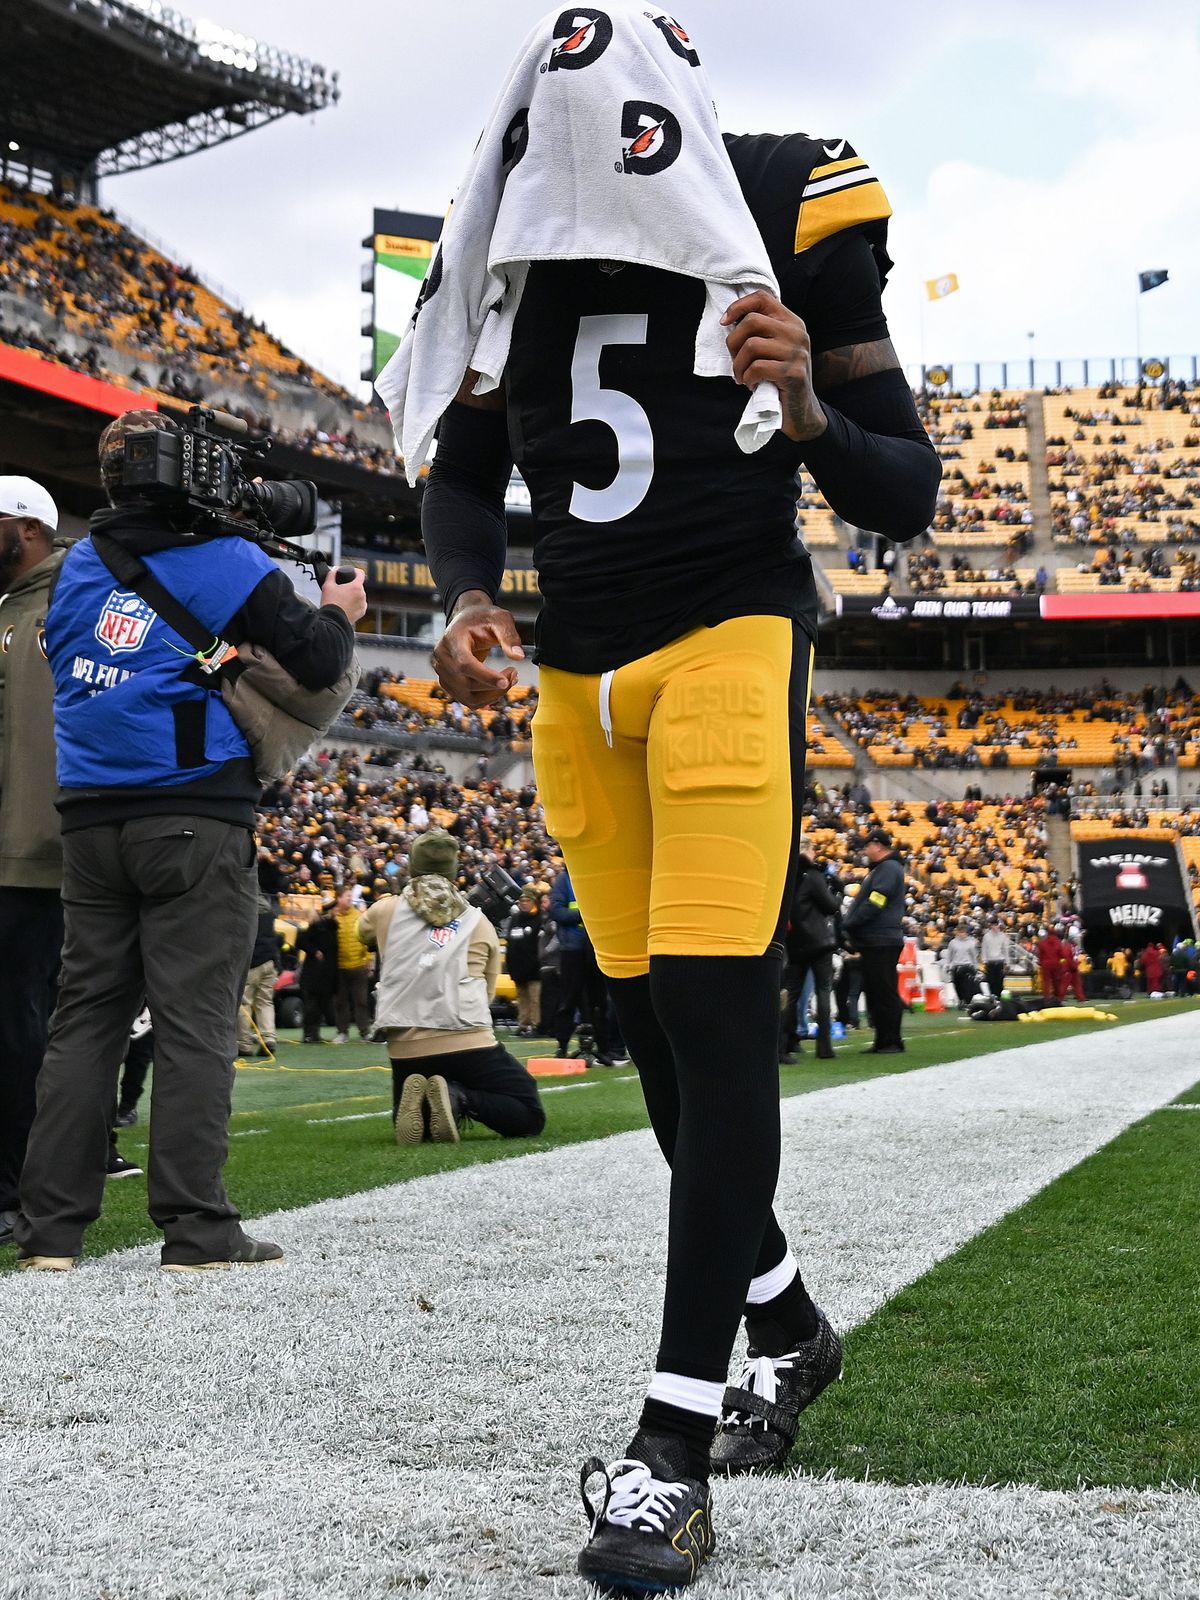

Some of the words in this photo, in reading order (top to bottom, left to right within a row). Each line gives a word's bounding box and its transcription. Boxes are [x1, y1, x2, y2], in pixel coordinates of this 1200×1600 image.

[568, 313, 654, 523] 5
[374, 560, 409, 586] THE
[911, 600, 943, 617] JOIN
[943, 600, 971, 617] OUR
[971, 600, 1012, 617] TEAM!
[100, 613, 139, 646] NFL
[72, 655, 95, 684] NFL
[665, 680, 766, 722] JESUS
[665, 728, 766, 770] KING
[1109, 904, 1163, 926] HEINZ
